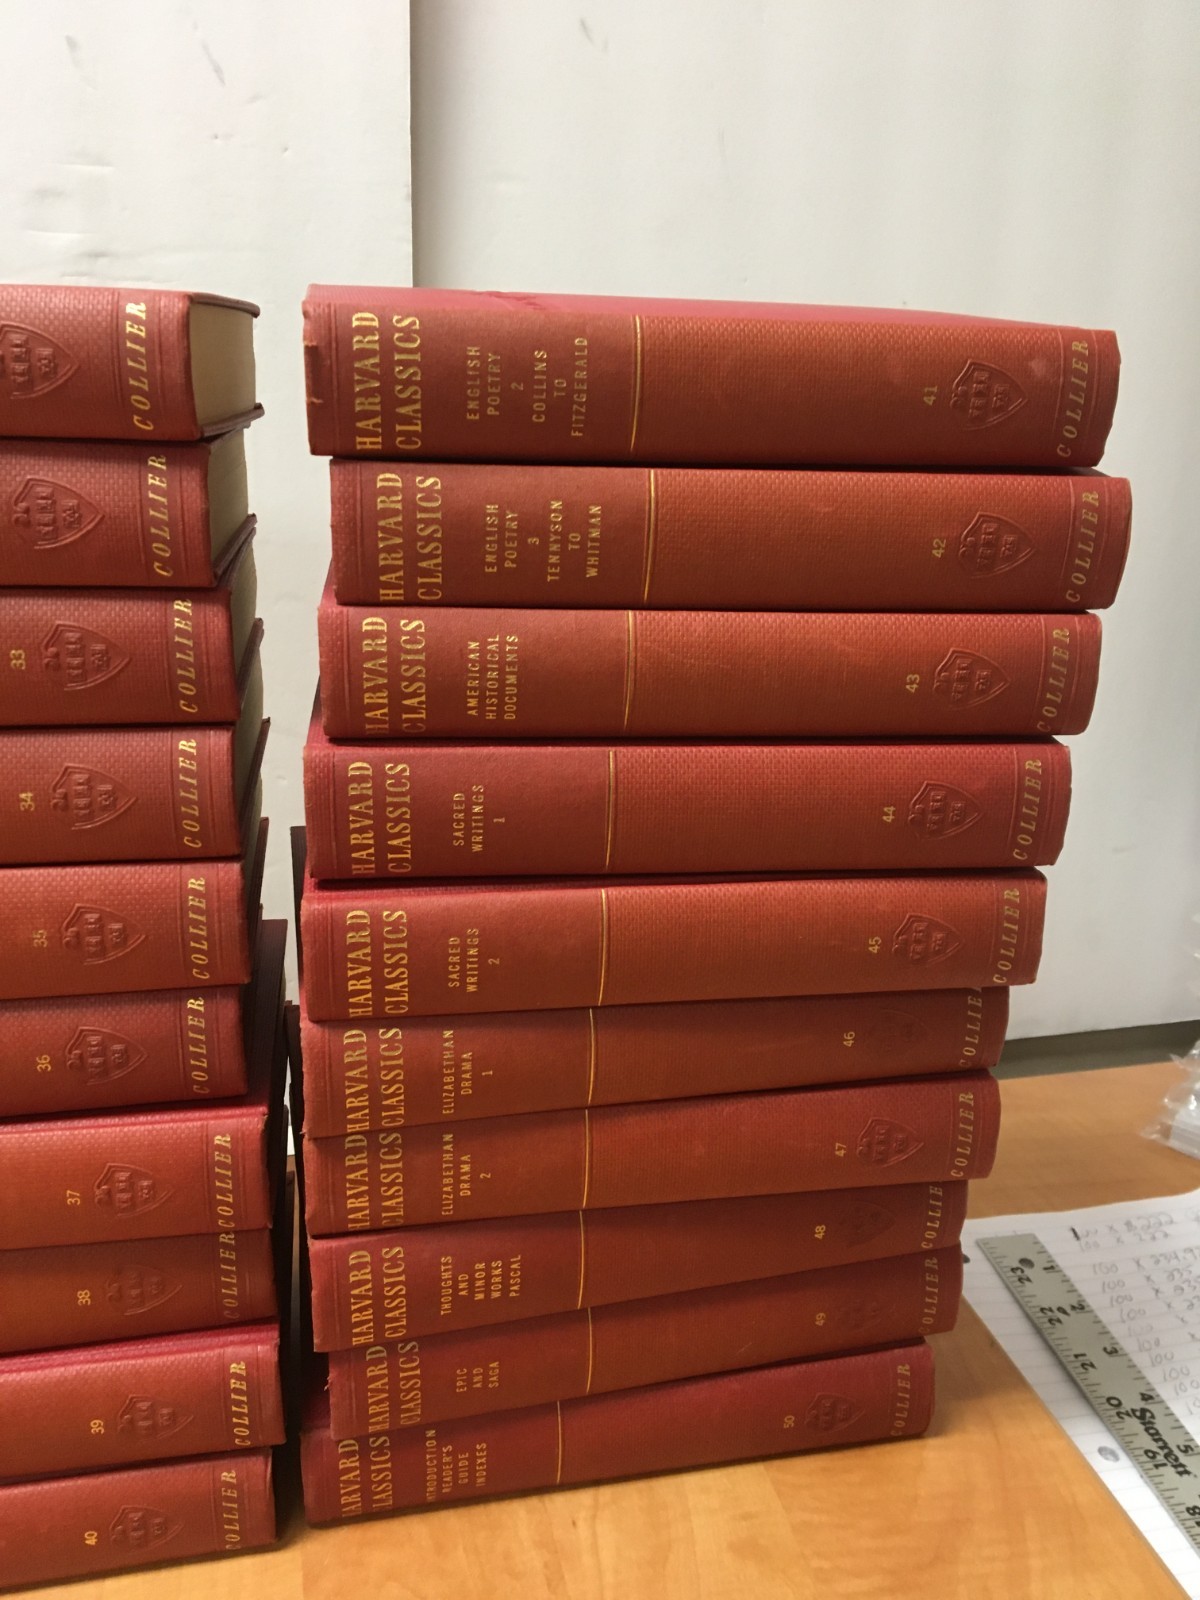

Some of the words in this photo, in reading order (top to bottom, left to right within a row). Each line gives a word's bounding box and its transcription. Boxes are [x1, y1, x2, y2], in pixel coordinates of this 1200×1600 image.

[125, 301, 154, 431] COLLIER
[352, 311, 383, 450] HARVARD
[393, 314, 422, 450] CLASSICS
[466, 345, 480, 420] ENGLISH
[487, 353, 500, 416] POETRY
[511, 381, 524, 391] 2
[533, 350, 547, 422] COLLINS
[554, 379, 567, 398] TO
[572, 337, 588, 437] FITZGERALD
[923, 385, 938, 406] 41
[1056, 340, 1089, 458] COLLIER
[148, 454, 174, 578] COLLIER
[377, 472, 404, 601] HARVARD
[415, 476, 443, 601] CLASSICS
[485, 504, 499, 573] ENGLISH
[505, 510, 519, 568] POETRY
[528, 537, 540, 545] 3
[547, 499, 563, 582] TENNYSON
[569, 532, 581, 551] TO
[586, 505, 602, 578] WHITMAN
[932, 538, 946, 558] 42
[1066, 490, 1100, 603] COLLIER
[10, 649, 26, 670] 33
[174, 599, 198, 713] COLLIER
[362, 616, 390, 735] HARVARD
[400, 619, 427, 734] CLASSICS
[467, 641, 480, 716] AMERICAN
[485, 634, 499, 720] HISTORICAL
[504, 635, 519, 720] DOCUMENTS
[906, 673, 920, 693] 43
[1037, 627, 1070, 733] COLLIER
[19, 792, 35, 812] 34
[179, 739, 202, 848] COLLIER
[348, 761, 375, 875] HARVARD
[385, 763, 412, 873] CLASSICS
[453, 793, 465, 846] SACRED
[472, 784, 485, 852] WRITINGS
[882, 806, 896, 823] 44
[1012, 759, 1042, 861] COLLIER
[33, 929, 48, 948] 35
[188, 877, 210, 979] COLLIER
[466, 927, 479, 992] WRITINGS
[868, 936, 882, 954] 45
[993, 887, 1021, 984] COLLIER
[347, 909, 373, 1017] HARVARD
[383, 909, 409, 1016] CLASSICS
[448, 937, 460, 988] SACRED
[187, 997, 210, 1094] COLLIER
[843, 1031, 856, 1048] 46
[958, 987, 983, 1068] COLLIE
[36, 1054, 51, 1072] 36
[343, 1028, 369, 1132] HARVARD
[379, 1027, 405, 1127] CLASSICS
[442, 1030, 454, 1114] ELIZABETHAN
[461, 1051, 473, 1095] DRAMA
[835, 1142, 847, 1157] 47
[950, 1091, 974, 1178] COLLIER
[67, 1190, 81, 1206] 37
[214, 1133, 235, 1228] COLLIER
[345, 1133, 371, 1230] HARVARD
[379, 1132, 404, 1226] CLASSICS
[442, 1133, 454, 1216] ELIZABETHAN
[460, 1153, 471, 1196] DRAMA
[814, 1224, 826, 1240] 48
[921, 1184, 943, 1249] COLLIE
[78, 1289, 91, 1306] 38
[219, 1231, 240, 1320] COLLIER
[349, 1250, 374, 1347] HARVARD
[382, 1246, 407, 1338] CLASSICS
[441, 1256, 452, 1316] THOUGHTS
[458, 1273, 469, 1296] AND
[474, 1262, 486, 1300] MINOR
[490, 1259, 503, 1299] WORKS
[510, 1254, 521, 1297] PASCAL
[918, 1256, 939, 1335] COLLIER
[1010, 1266, 1033, 1284] 23
[814, 1312, 826, 1326] 49
[1040, 1306, 1063, 1326] 22
[398, 1341, 421, 1425] CLASSICS
[456, 1367, 468, 1392] EPIC
[473, 1367, 483, 1388] AND
[489, 1361, 500, 1388] SAGA
[1073, 1353, 1098, 1371] 21
[1103, 1346, 1119, 1355] 3
[229, 1361, 251, 1446] COLLIER
[366, 1345, 389, 1431] HARVARD
[783, 1415, 795, 1428] 50
[1105, 1396, 1133, 1420] 20
[1139, 1392, 1155, 1402] 4
[90, 1419, 104, 1435] 39
[1130, 1407, 1192, 1477] Starrett
[1143, 1449, 1169, 1470] 19
[1176, 1444, 1194, 1454] 5
[369, 1435, 393, 1510] LASSICS
[442, 1444, 453, 1493] READER'S
[458, 1452, 469, 1484] GUIDE
[476, 1442, 487, 1487] INDEXES
[84, 1531, 98, 1546] 40
[221, 1469, 241, 1550] COLLIER
